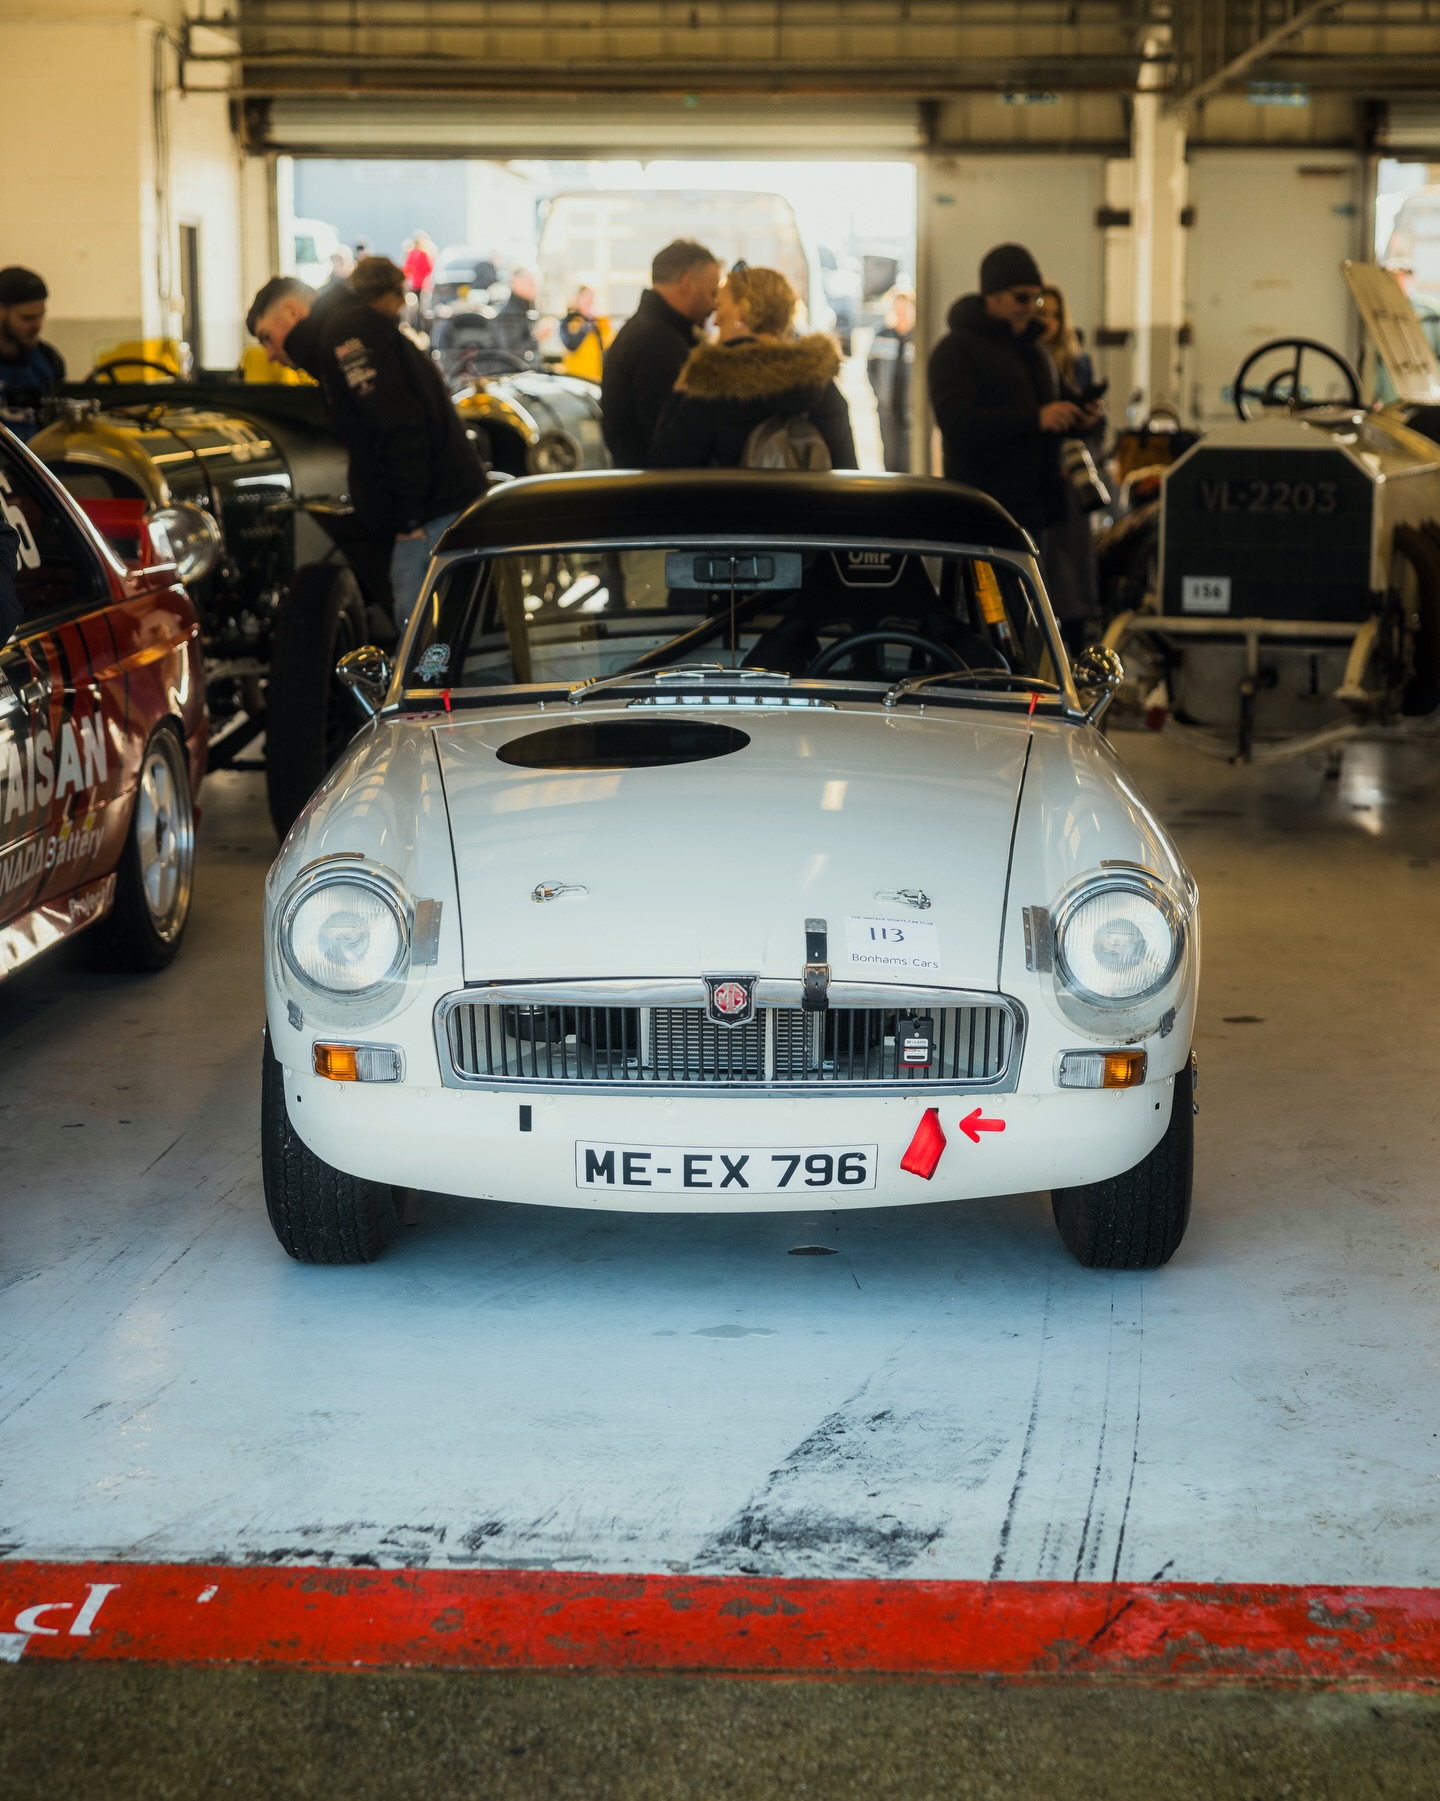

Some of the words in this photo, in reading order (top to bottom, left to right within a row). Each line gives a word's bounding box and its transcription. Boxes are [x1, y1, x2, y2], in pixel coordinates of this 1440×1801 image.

[1192, 582, 1223, 600] 156
[45, 826, 105, 869] Battery
[870, 926, 905, 943] 113
[852, 953, 908, 966] Bonhams
[912, 958, 939, 969] Cars
[716, 984, 745, 1012] MG
[585, 1149, 750, 1188] ME-EX
[771, 1152, 868, 1188] 796
